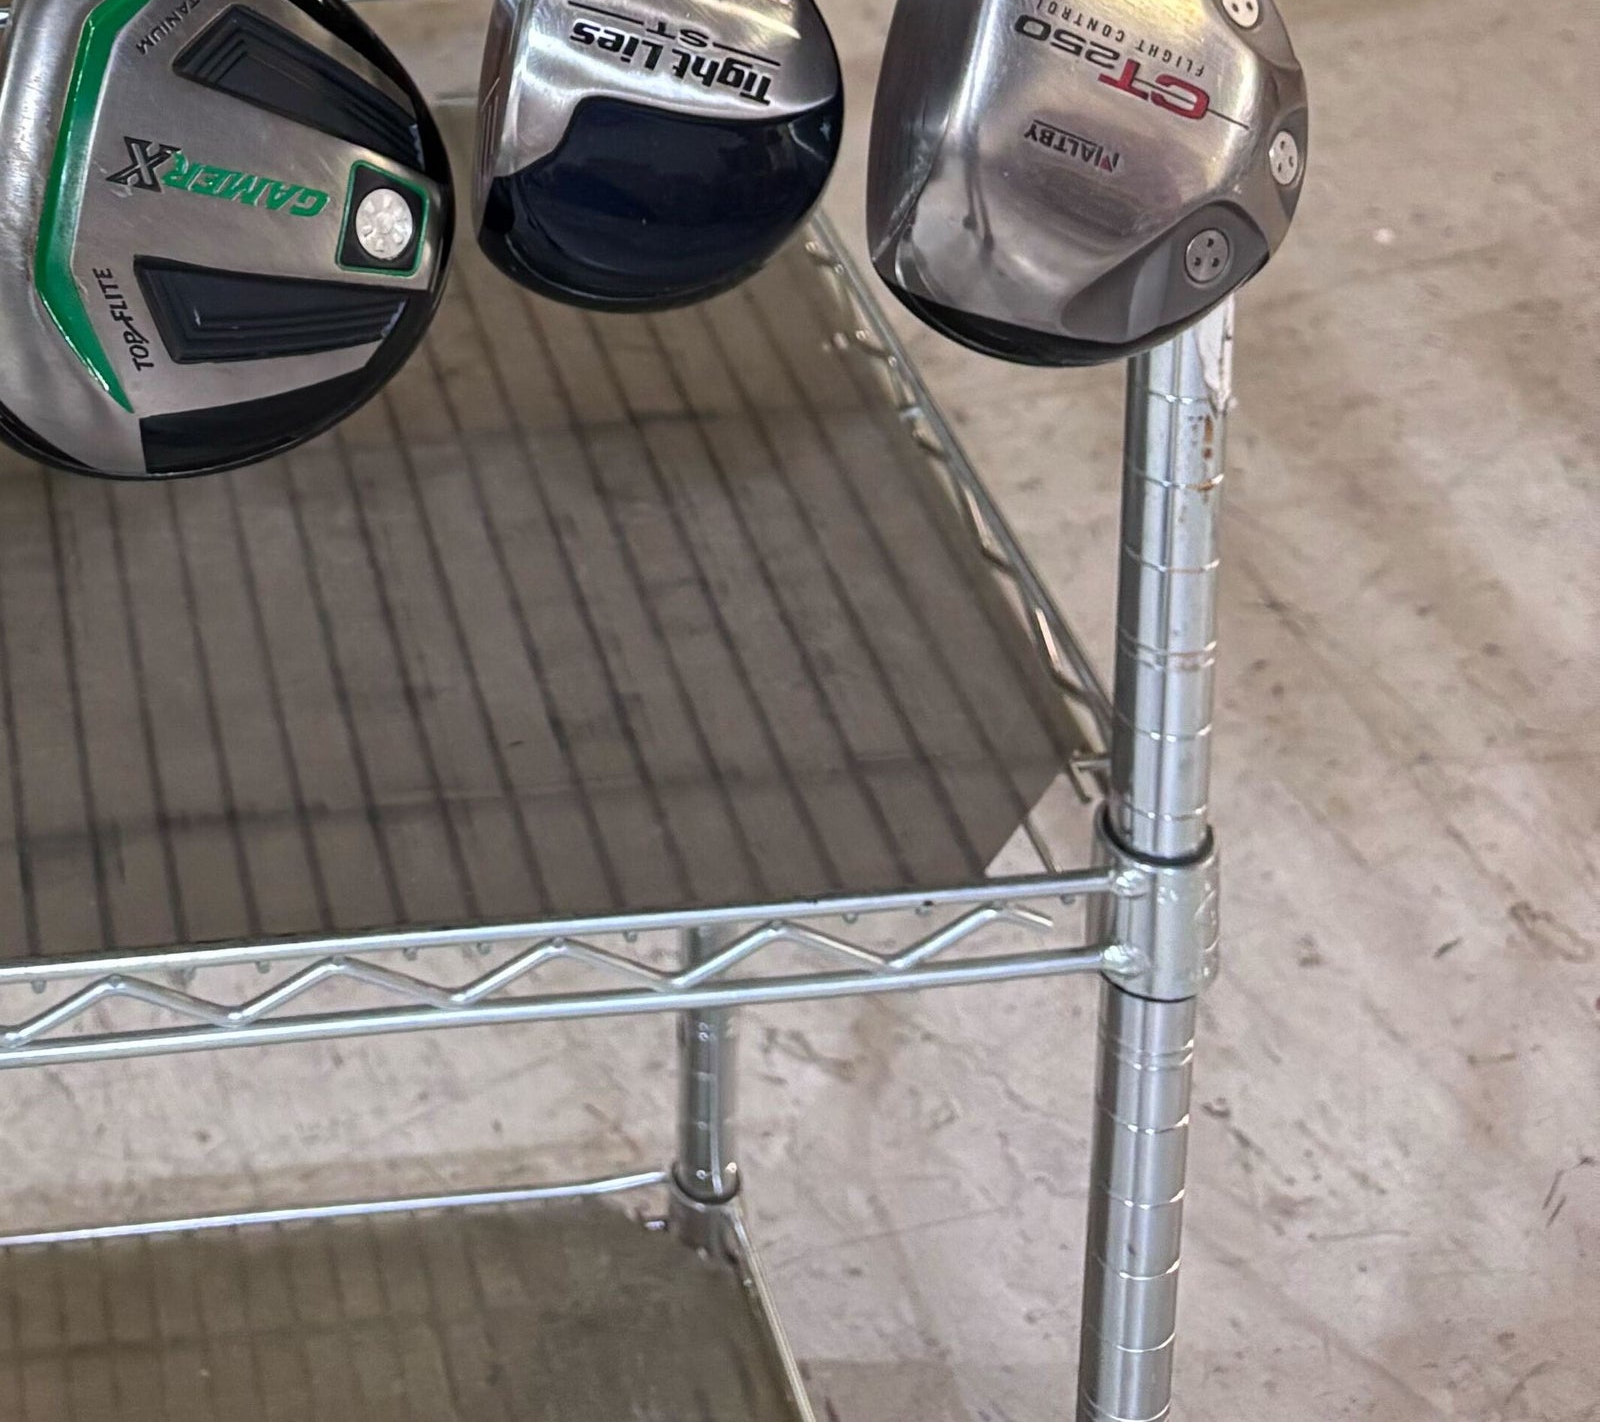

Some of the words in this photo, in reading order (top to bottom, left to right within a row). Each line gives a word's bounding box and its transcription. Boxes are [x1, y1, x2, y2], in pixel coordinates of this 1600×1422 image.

[568, 19, 664, 69] Lies
[646, 15, 714, 49] ST
[1135, 37, 1206, 77] FLIGHT
[671, 51, 773, 107] Tight
[1014, 13, 1211, 121] CT250
[1023, 122, 1122, 172] MALTBY
